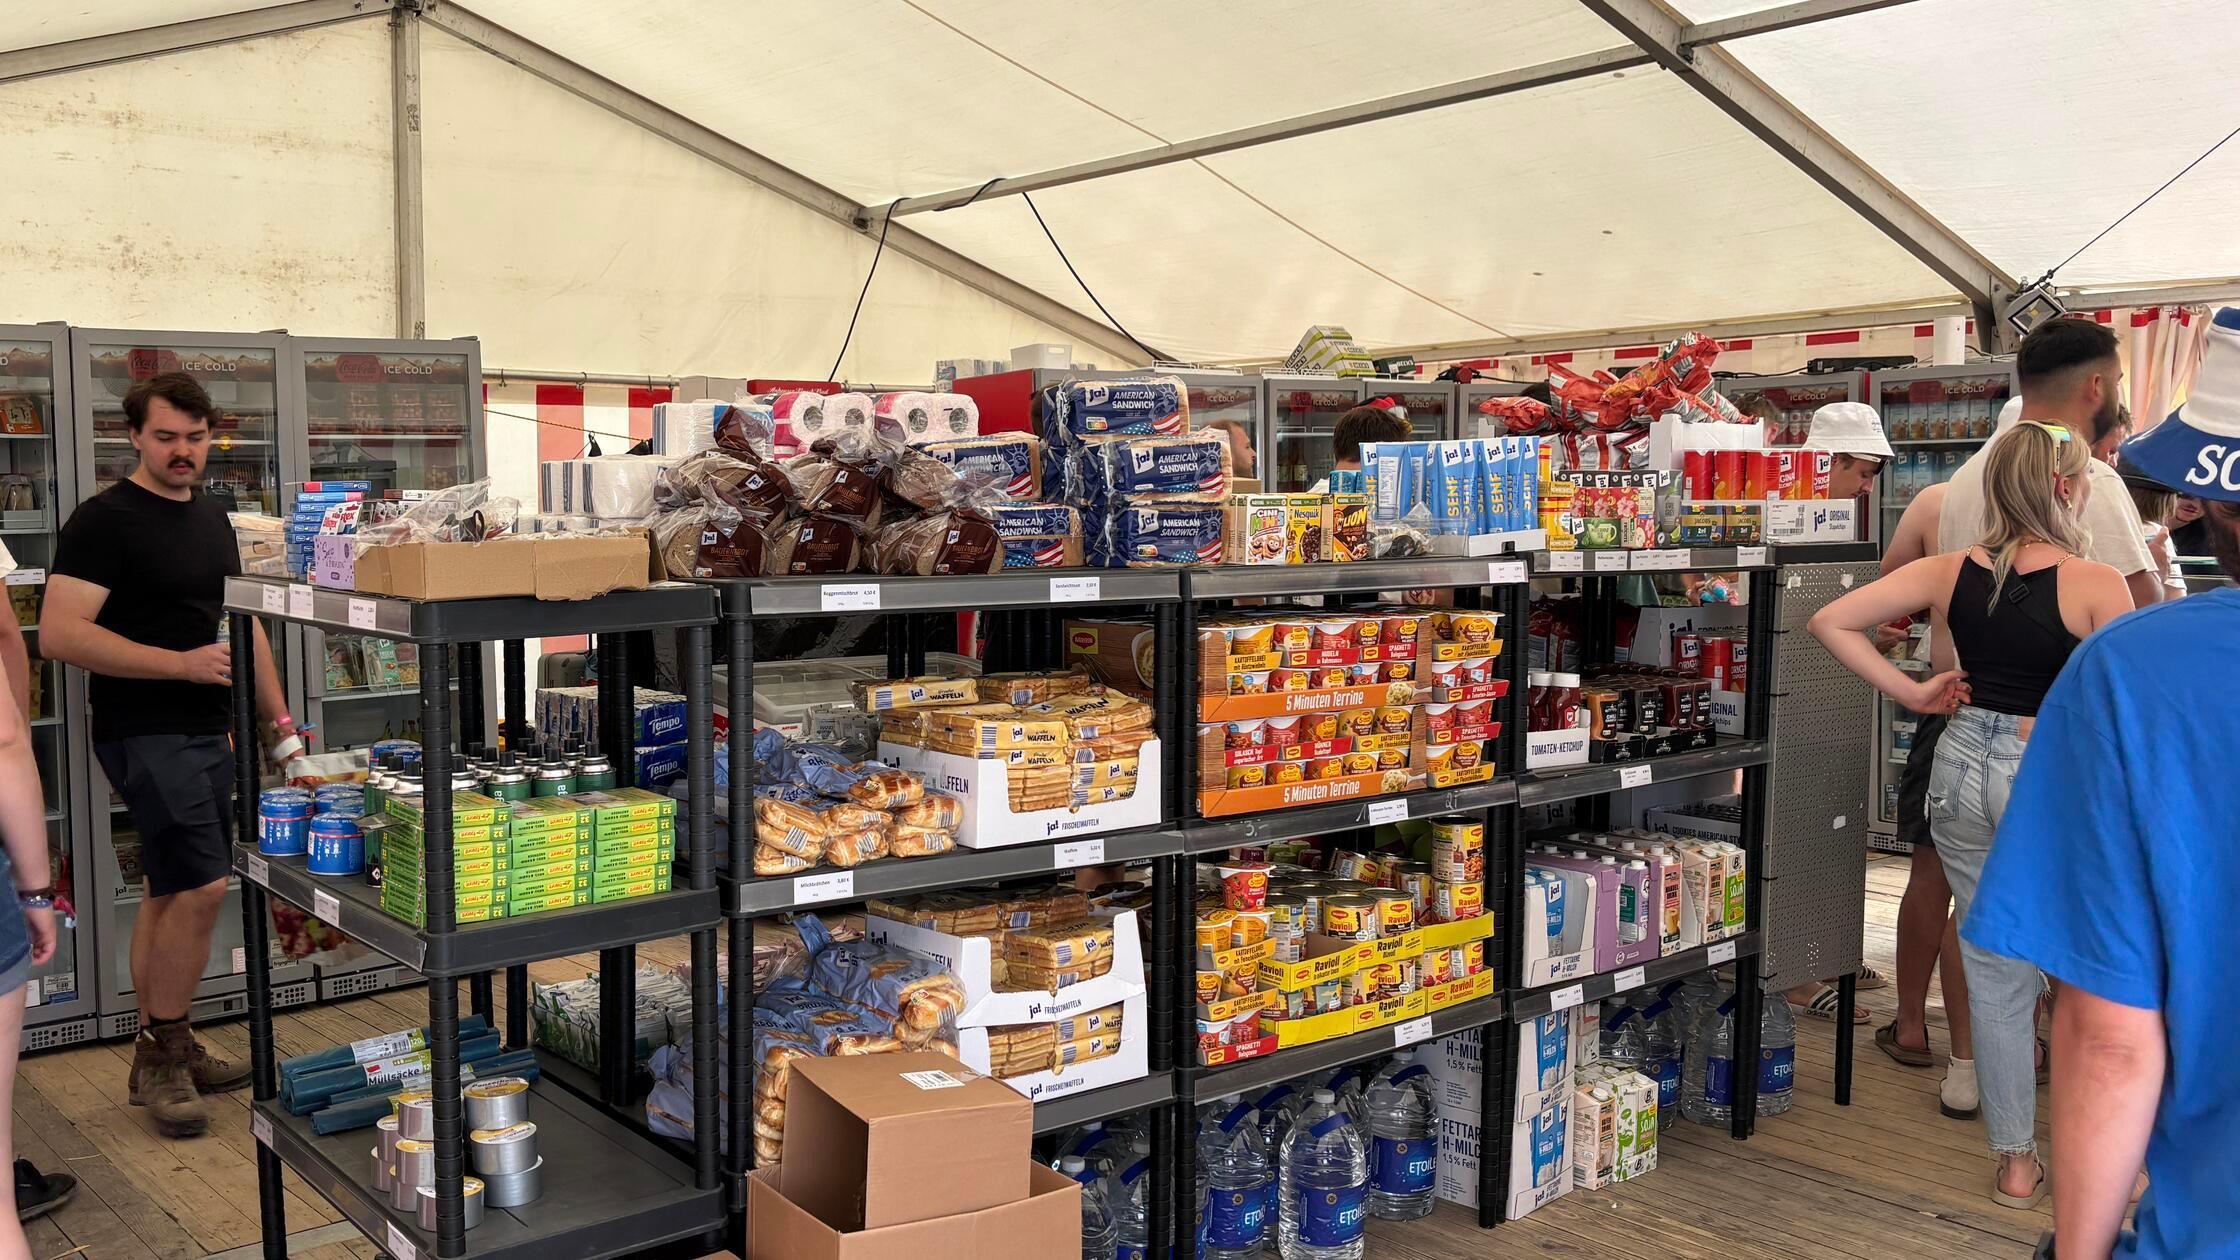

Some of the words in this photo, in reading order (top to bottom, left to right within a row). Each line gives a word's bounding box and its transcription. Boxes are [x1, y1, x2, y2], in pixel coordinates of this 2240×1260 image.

[182, 361, 201, 371] ICE
[205, 362, 236, 372] COLD
[384, 365, 401, 374] ICE
[404, 366, 433, 375] COLD
[1089, 387, 1106, 403] ja!
[1113, 391, 1155, 400] AMERICAN
[1804, 392, 1827, 400] COLD
[1945, 387, 1960, 395] ICE
[1962, 385, 1985, 394] COLD
[1112, 400, 1155, 409] SANDWICH
[1135, 451, 1151, 468] ja!
[1158, 453, 1198, 464] AMERICAN
[1366, 451, 1376, 462] ja
[1444, 449, 1459, 463] ja!
[1487, 446, 1501, 460] ja!
[1159, 463, 1199, 474] SANDWICH
[1366, 475, 1377, 505] ENF
[1446, 476, 1459, 517] SENF
[1489, 473, 1504, 514] SENF
[1257, 509, 1278, 517] CINI
[1294, 509, 1320, 519] Nesquik
[1343, 507, 1368, 527] LION
[1813, 508, 1826, 533] ja!
[1829, 510, 1850, 521] ORIGINAL
[1000, 517, 1044, 527] AMERICAN
[1140, 513, 1156, 529] ja!
[1163, 518, 1201, 527] AMERICAN
[703, 534, 715, 543] ja!
[1160, 528, 1200, 537] SANDWICH
[1684, 641, 1698, 655] ja!
[911, 688, 924, 701] ja!
[929, 691, 964, 701] WAFFELN
[1286, 696, 1292, 710] 5
[1293, 692, 1331, 710] Minuten
[1333, 690, 1364, 707] Terrine
[1065, 697, 1110, 715] WAFFELN
[1710, 702, 1738, 717] IGINAL
[648, 716, 681, 734] Tempo
[1710, 716, 1731, 726] elchips
[1012, 726, 1024, 742] ja!
[1027, 734, 1056, 743] WAFFELN
[1531, 739, 1584, 756] TOMATEN-KETCHUP
[1010, 750, 1023, 763] ja!
[647, 760, 679, 779] Tempo
[1110, 765, 1121, 777] ja!
[1103, 787, 1114, 798] ja!
[1284, 790, 1290, 803] 5
[1291, 785, 1328, 803] Minuten
[1329, 780, 1360, 797] Terrine
[1046, 820, 1059, 836] ja!
[1672, 826, 1696, 837] COOKIES
[1697, 830, 1728, 842] AMERICAN
[1729, 835, 1741, 844] STY
[1550, 884, 1560, 899] ja!
[1330, 922, 1353, 931] Ravioli
[1388, 915, 1410, 924] Ravioli
[1085, 938, 1097, 952] ja!
[1377, 937, 1404, 952] Ravioli
[1259, 961, 1285, 978] Ravioli
[1314, 955, 1341, 972] Ravioli
[1550, 962, 1561, 978] ja!
[1450, 979, 1474, 994] Ravioli
[1029, 1003, 1042, 1019] ja!
[1378, 996, 1404, 1013] Ravioli
[1089, 1016, 1100, 1028] ja!
[1546, 1016, 1556, 1031] ja!
[1466, 1062, 1482, 1074] Fett
[368, 1066, 420, 1086] Müllsäcke
[1030, 1083, 1043, 1099] ja!
[1540, 1094, 1551, 1110] ja!
[1542, 1113, 1552, 1128] ja!
[1442, 1119, 1481, 1141] FETTAR
[1442, 1138, 1481, 1159] H-MILC
[1409, 1155, 1437, 1175] ETOILE
[1462, 1158, 1477, 1170] Fett
[1534, 1190, 1545, 1208] ja!
[1244, 1203, 1266, 1226] ETOIL
